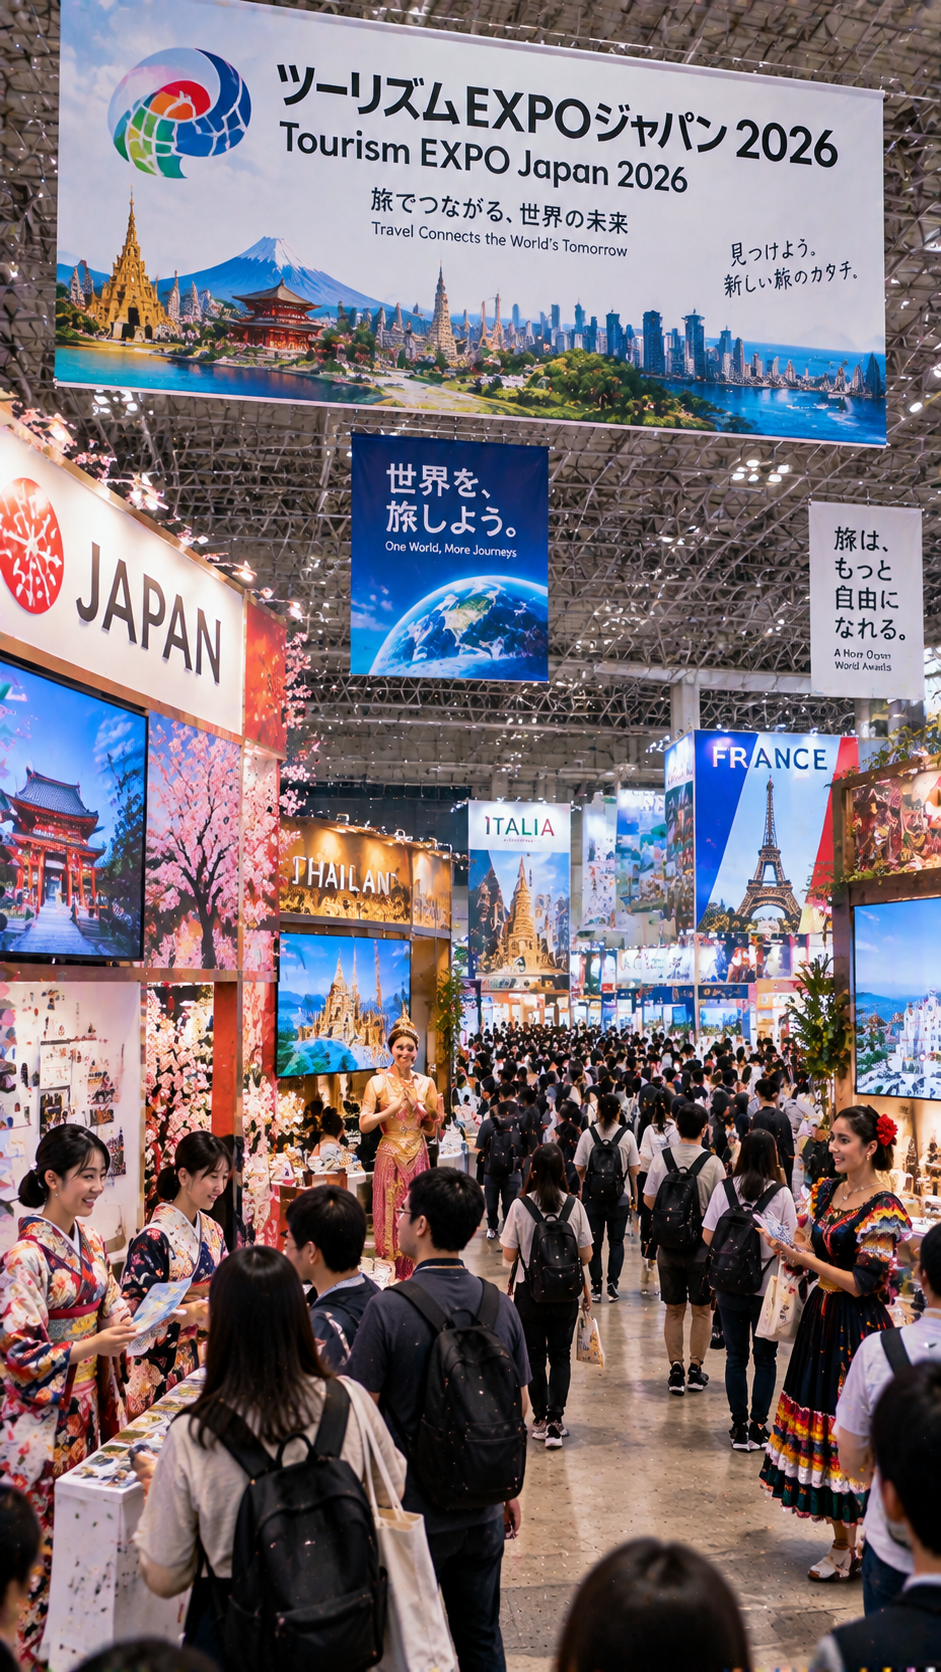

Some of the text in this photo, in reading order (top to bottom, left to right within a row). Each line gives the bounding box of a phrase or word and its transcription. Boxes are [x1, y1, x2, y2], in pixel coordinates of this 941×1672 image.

[277, 64, 839, 168] ツーリズムEXPOジャパン 2026
[279, 121, 688, 193] Tourism EXPO Japan 2026
[371, 187, 628, 234] 旅でつながる、世界の未来
[371, 221, 628, 257] Travel Connects the World's Tomorrow
[731, 239, 815, 267] 見つけよう。
[724, 261, 858, 298] 新しい旅のカタチ。
[386, 463, 491, 498] 世界を、
[386, 500, 517, 537] 旅しよう。
[385, 540, 517, 559] One World, More Journeys
[834, 526, 888, 552] 旅は、
[834, 557, 892, 581] もっと
[835, 585, 899, 611] 自由に
[76, 541, 222, 684] JAPAN
[834, 616, 906, 641] なれる。
[834, 648, 841, 657] A
[712, 746, 828, 770] FRANCE
[485, 816, 555, 836] ITALIA
